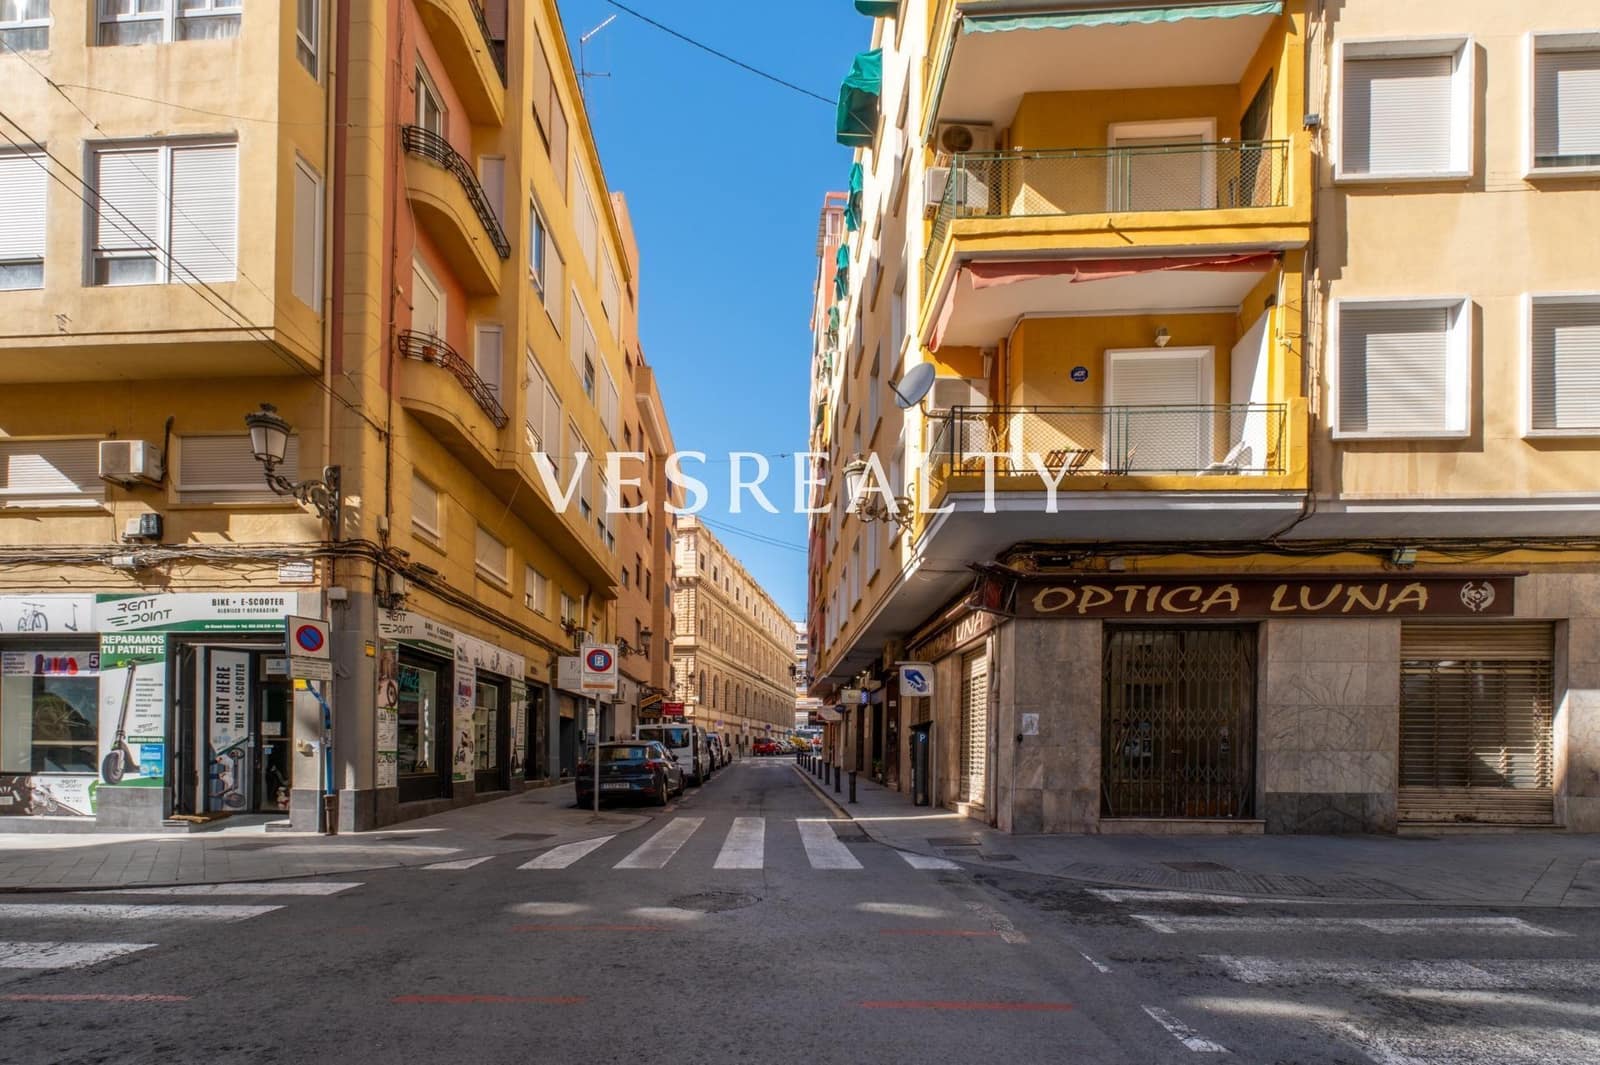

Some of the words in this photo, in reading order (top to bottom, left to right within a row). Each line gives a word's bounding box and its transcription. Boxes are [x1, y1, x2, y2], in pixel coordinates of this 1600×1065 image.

[117, 599, 157, 612] RENT
[212, 598, 229, 606] BIKE
[241, 598, 284, 606] E-SCOOTER
[1032, 584, 1240, 614] OPTICA
[1270, 582, 1428, 613] LUNA
[131, 609, 172, 624] POINT
[102, 635, 164, 644] REPARAMOS
[102, 645, 114, 654] TU
[117, 645, 165, 654] PATINETE
[216, 666, 230, 693] HERE
[235, 664, 245, 702] E-SCOOTER
[216, 697, 230, 723] RENT
[235, 712, 244, 728] BIKE
[920, 734, 926, 742] P
